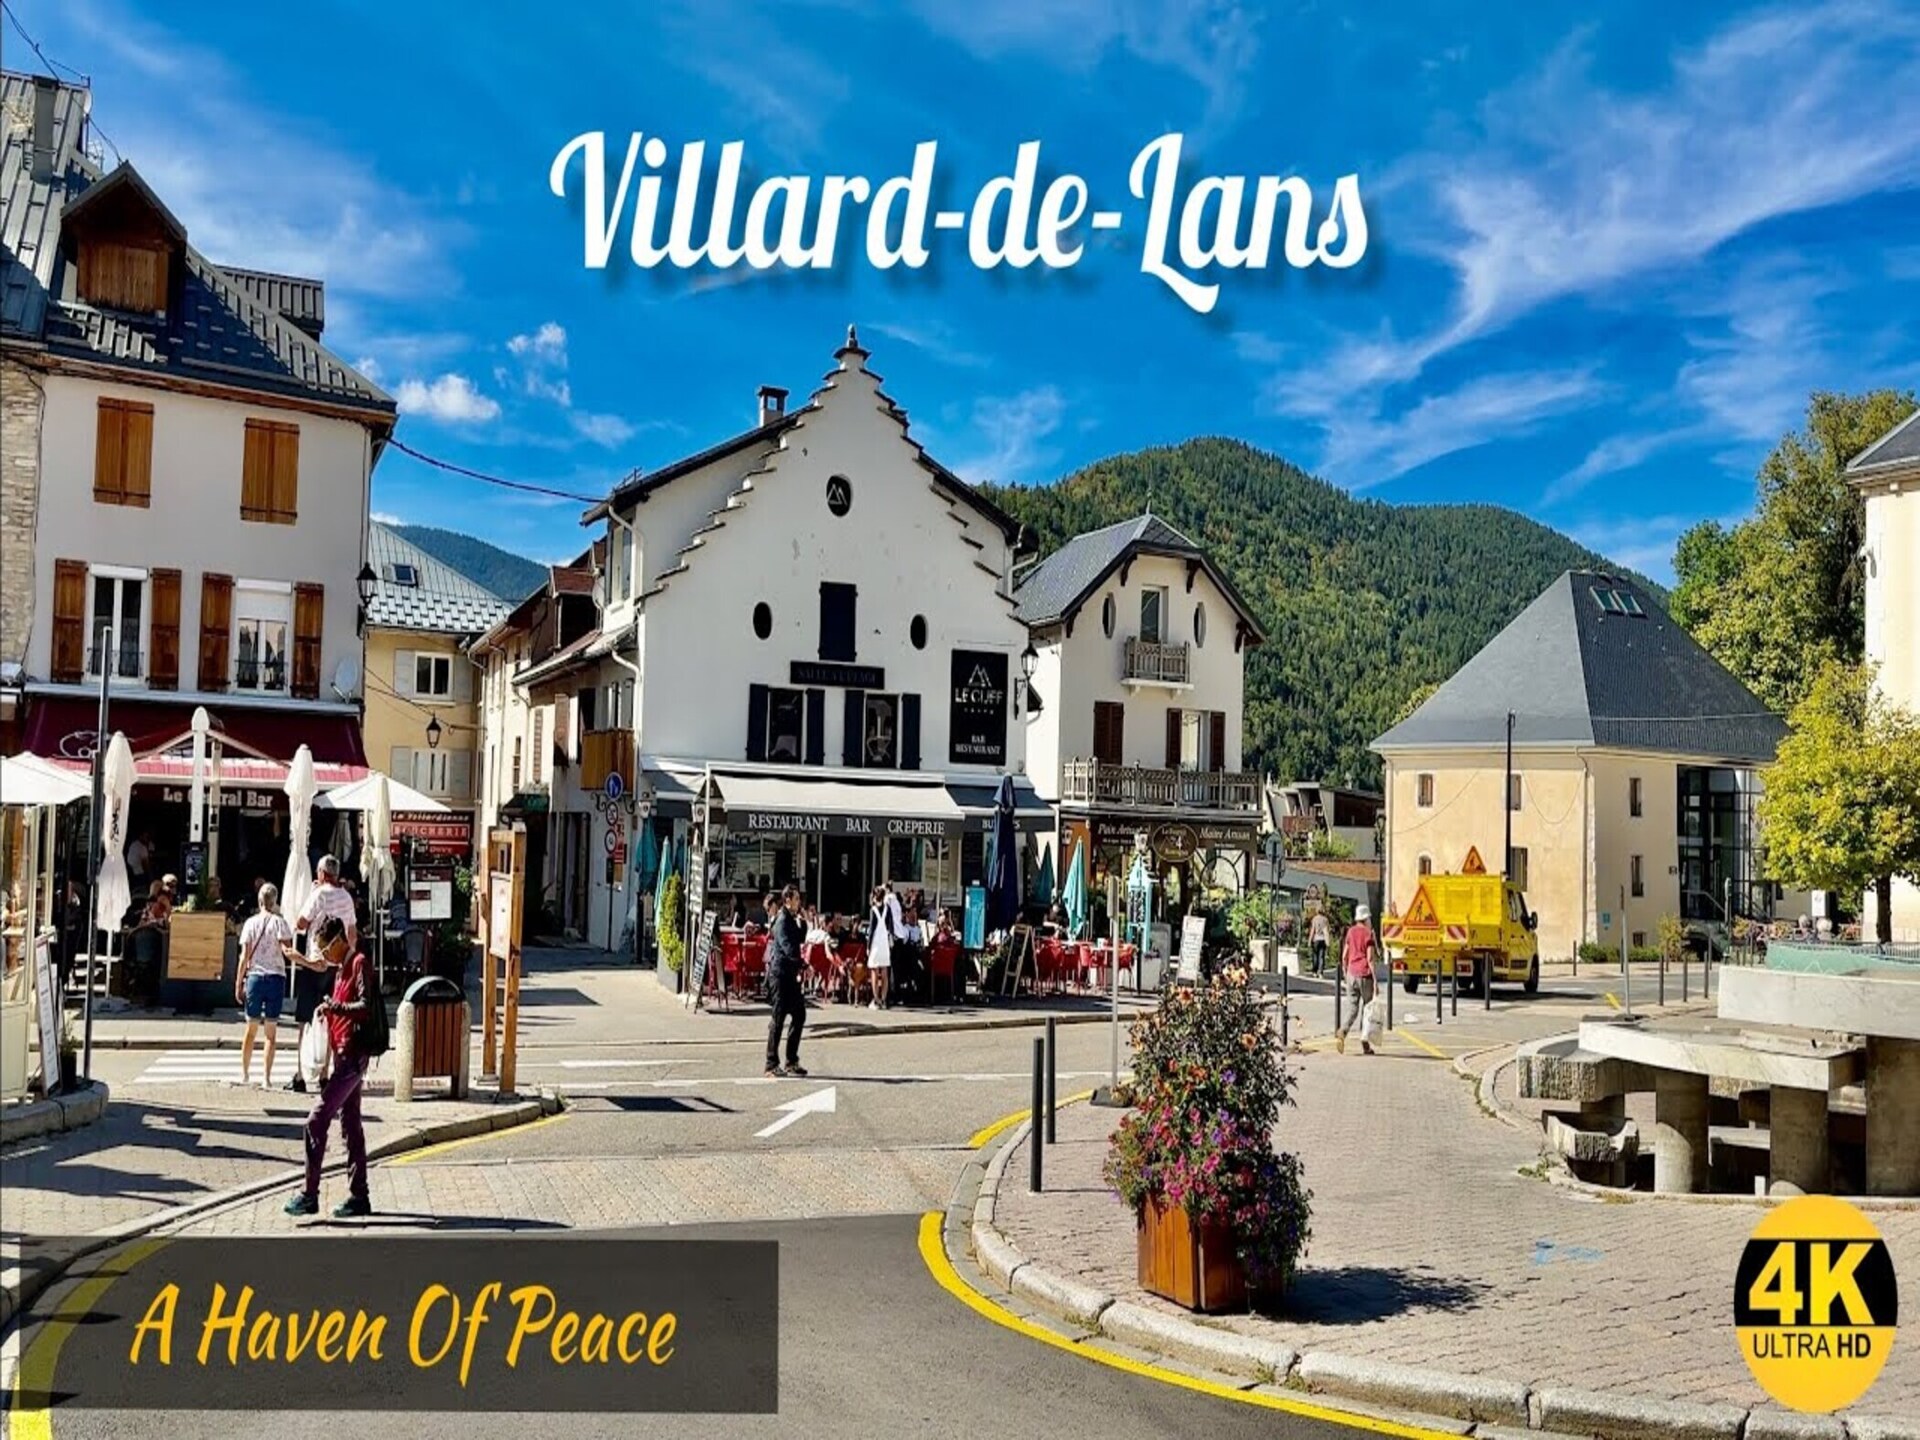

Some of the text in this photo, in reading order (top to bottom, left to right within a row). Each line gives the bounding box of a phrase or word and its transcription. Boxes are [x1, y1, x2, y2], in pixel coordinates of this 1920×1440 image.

[955, 687, 969, 702] LE
[955, 743, 1001, 755] RESTAURANT
[163, 787, 183, 802] Le
[246, 790, 273, 807] Bar
[749, 813, 830, 831] RESTAURANT
[845, 817, 871, 833] BAR
